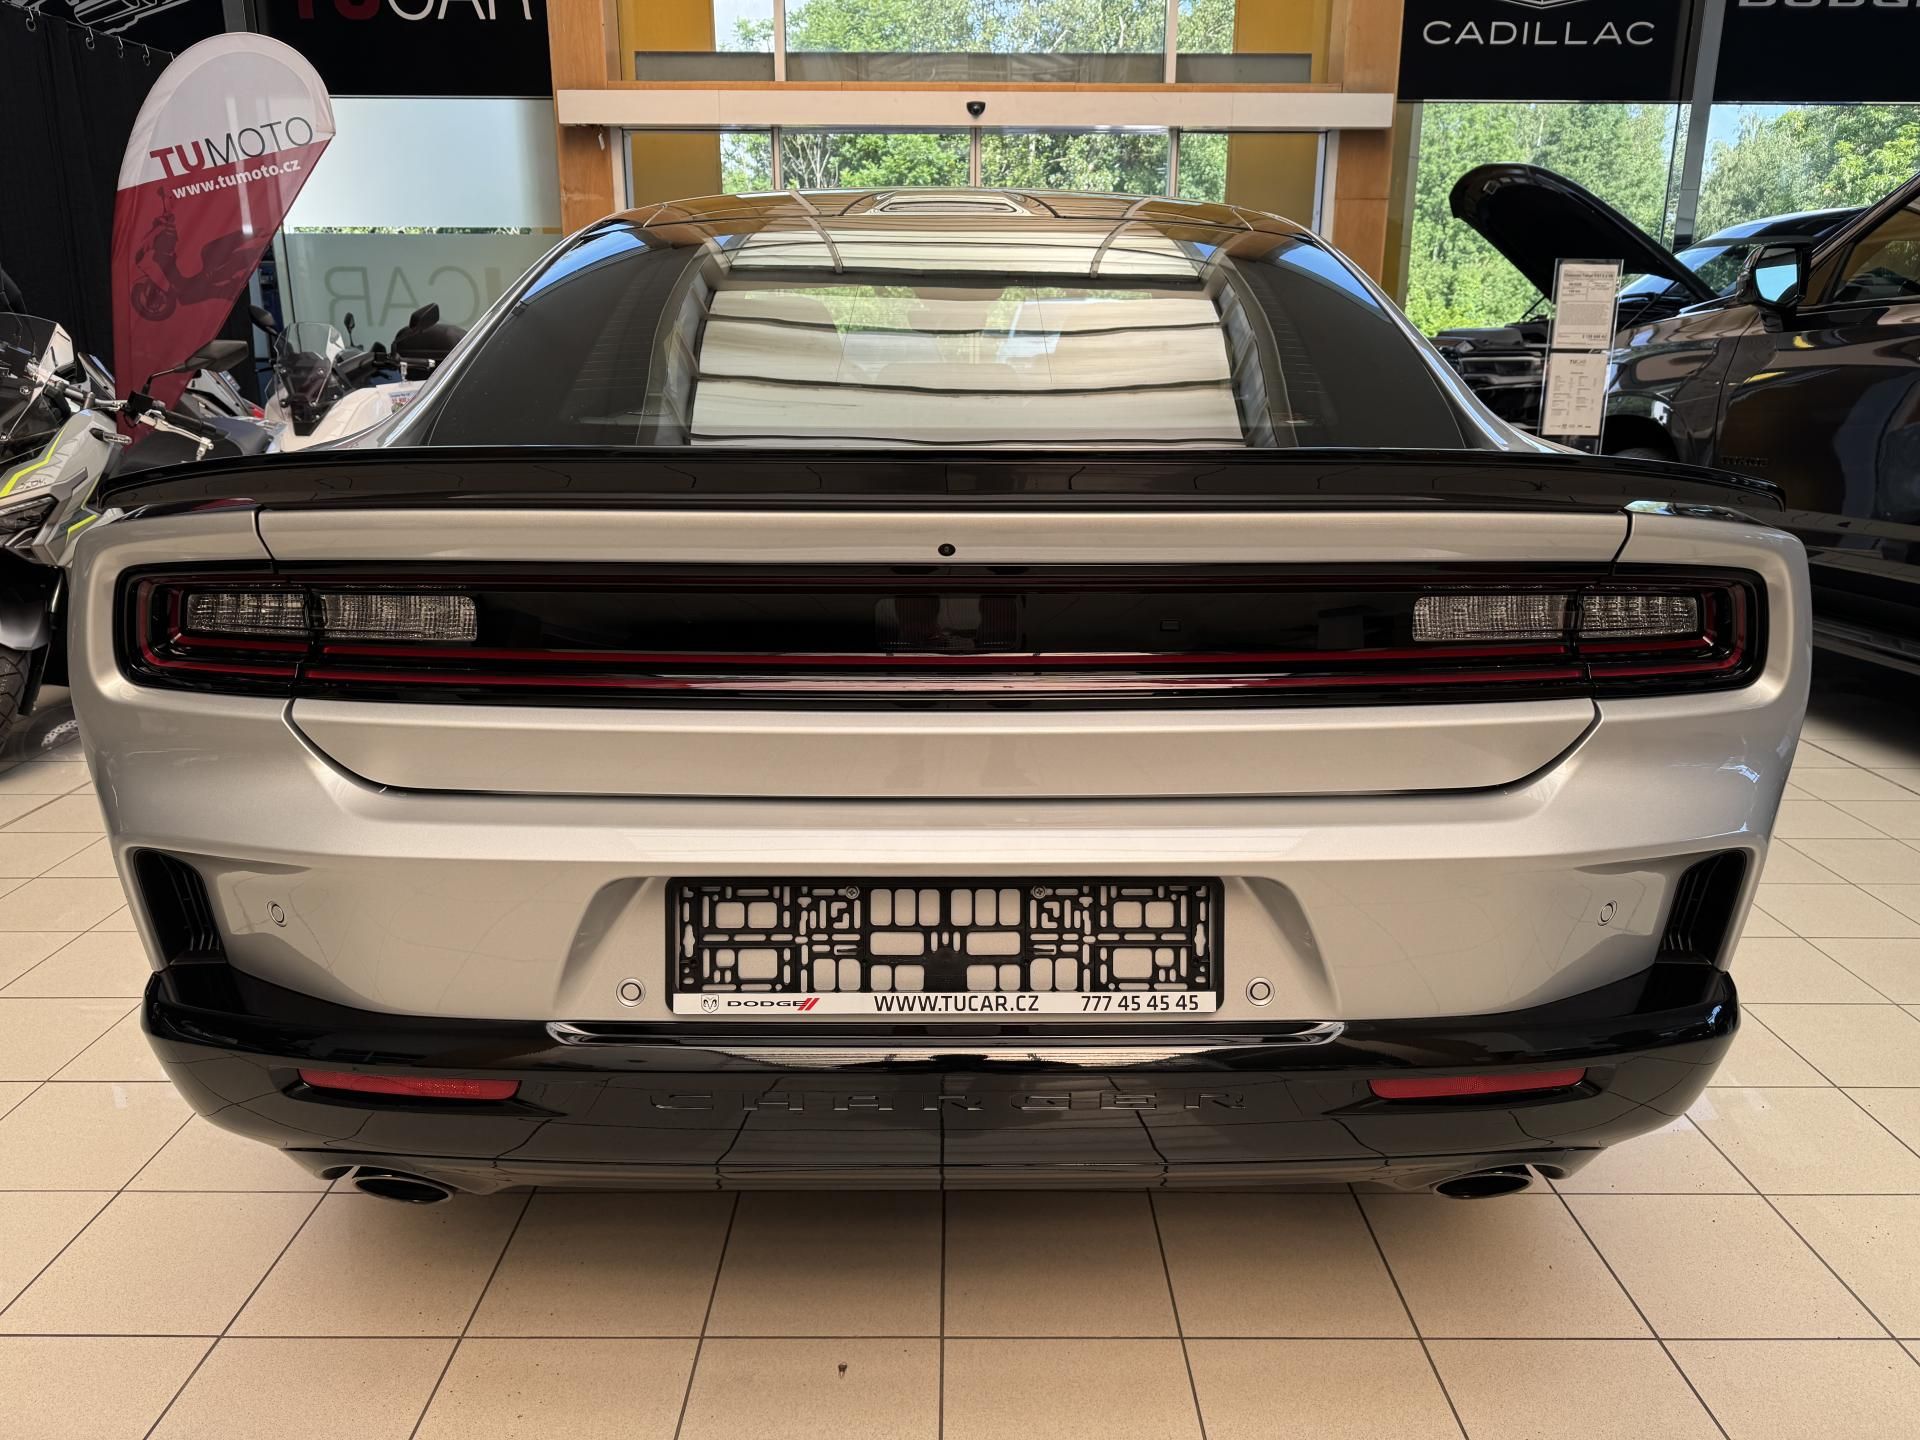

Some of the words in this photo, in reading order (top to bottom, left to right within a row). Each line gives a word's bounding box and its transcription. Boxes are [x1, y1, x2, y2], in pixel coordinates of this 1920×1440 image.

[1423, 20, 1655, 45] CADILLAC
[149, 116, 313, 179] TUMOTO
[172, 158, 301, 200] www.tumoto.cz
[874, 995, 1039, 1012] WWW.TUCAR.CZ
[1081, 995, 1113, 1012] 777
[1117, 995, 1141, 1011] 45
[1146, 994, 1170, 1011] 45
[1175, 994, 1199, 1010] 45
[650, 1094, 1246, 1111] CHARGER
